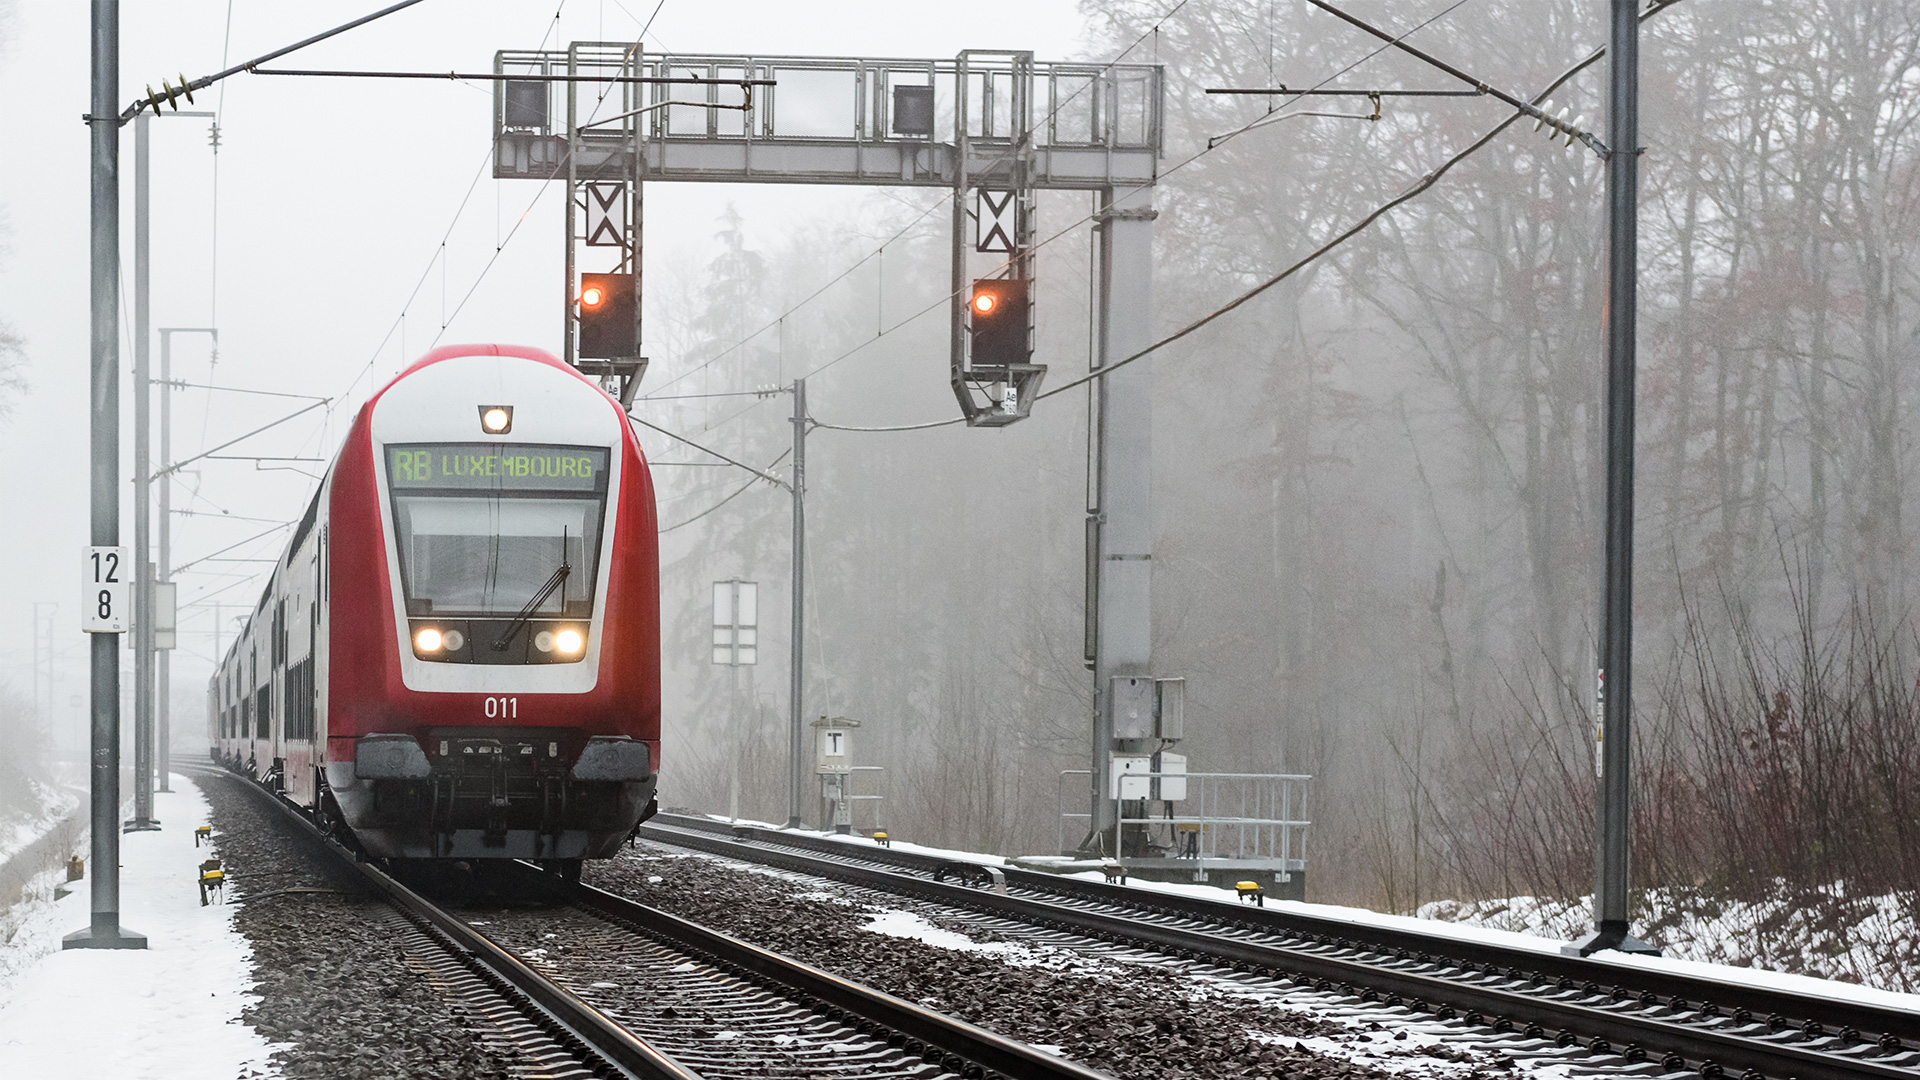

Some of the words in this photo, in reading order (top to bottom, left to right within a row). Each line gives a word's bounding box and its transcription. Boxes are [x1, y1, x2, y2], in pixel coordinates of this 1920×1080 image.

[608, 384, 618, 395] Ae
[1005, 390, 1017, 402] Ae
[394, 451, 432, 481] RB
[442, 454, 593, 478] LUXEMBOURG
[90, 552, 119, 583] 12
[98, 589, 111, 620] 8
[484, 696, 517, 718] 011
[827, 732, 842, 753] T
